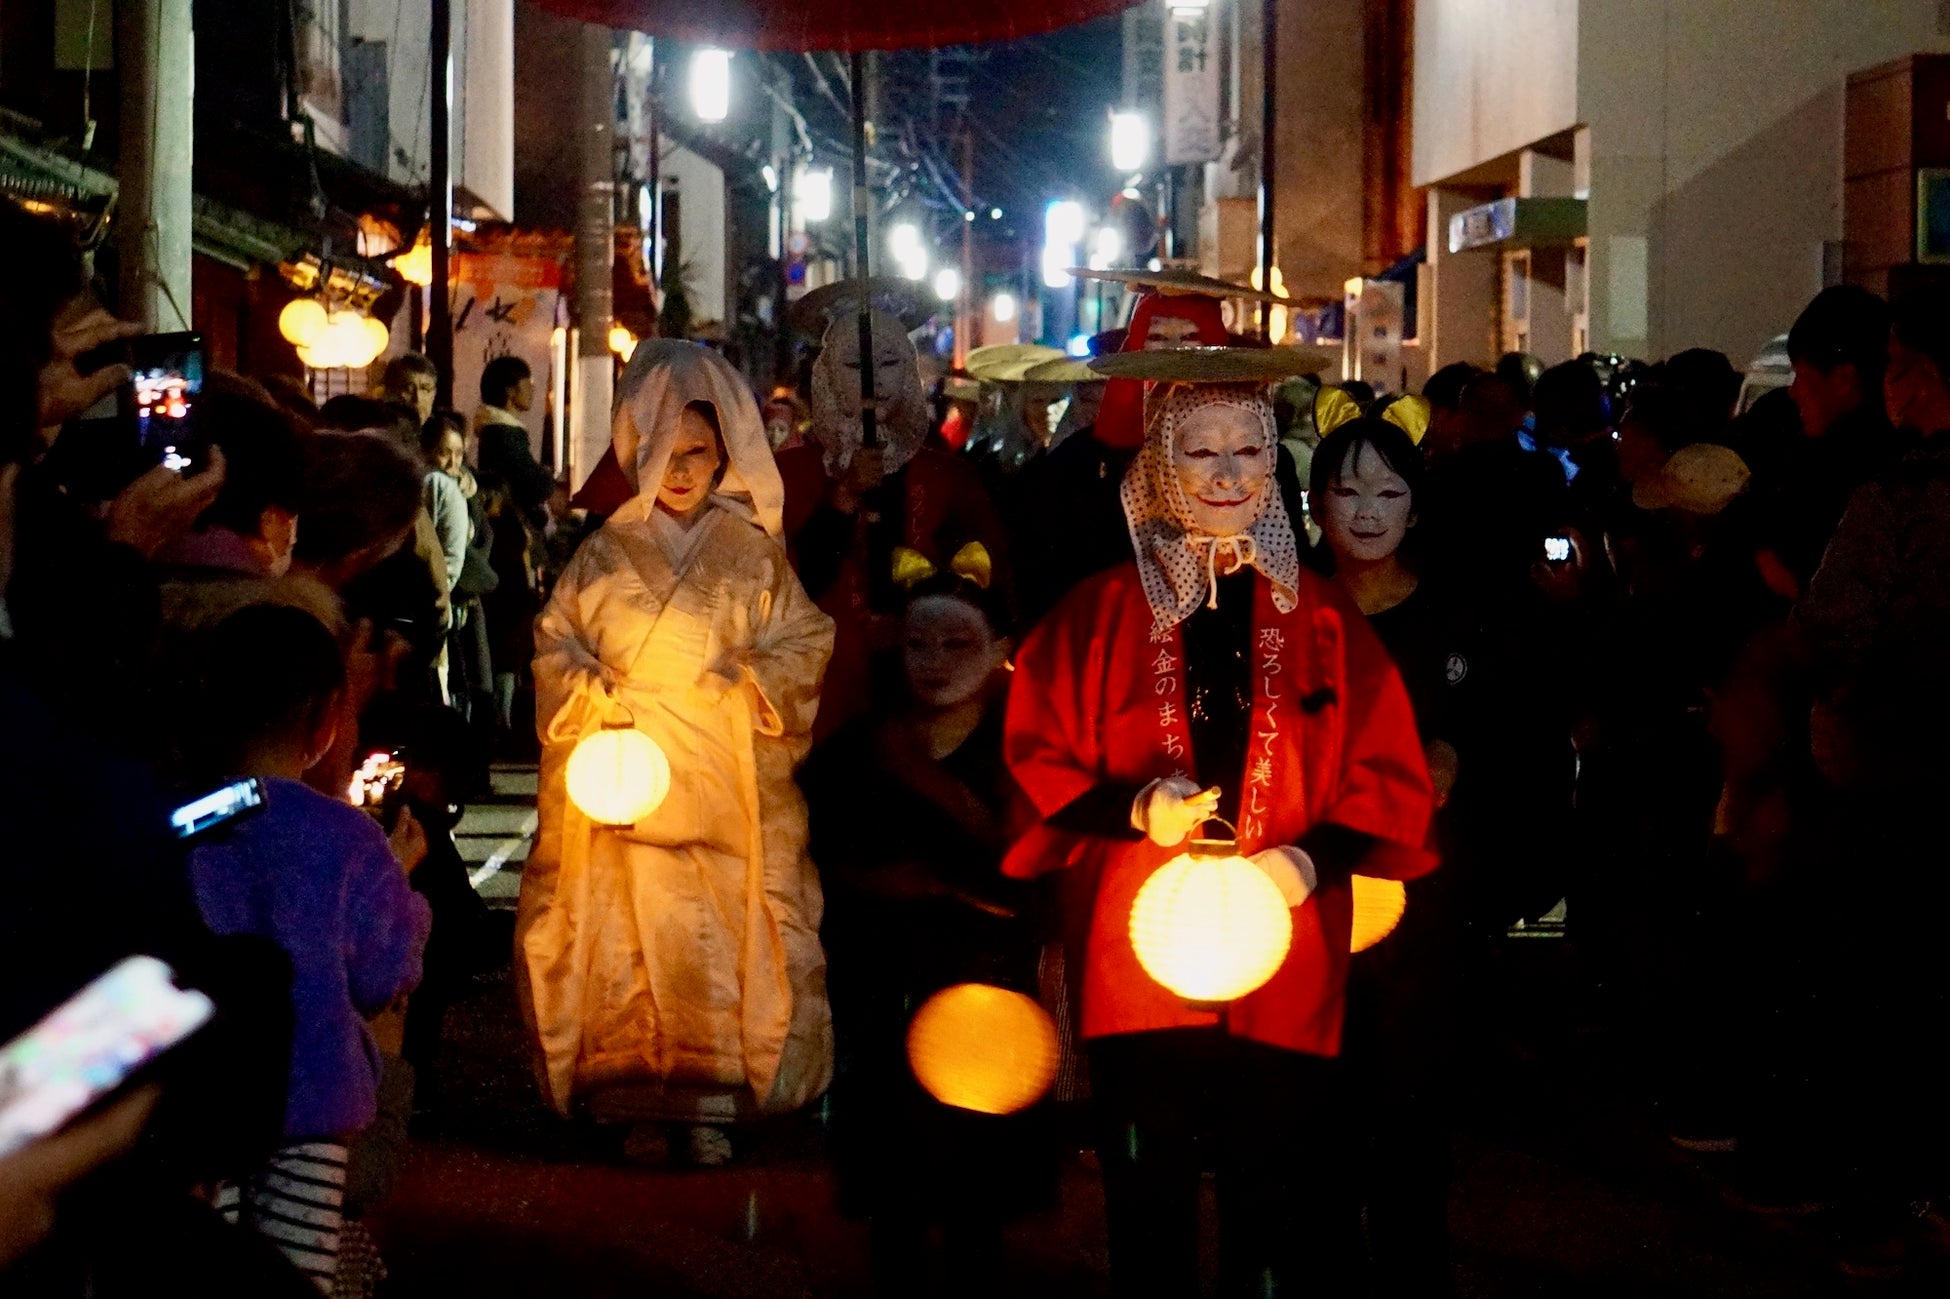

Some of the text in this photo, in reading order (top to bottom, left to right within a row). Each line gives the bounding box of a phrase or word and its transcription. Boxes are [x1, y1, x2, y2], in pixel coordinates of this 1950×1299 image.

[1244, 627, 1285, 840] 恐ろしくて美しい
